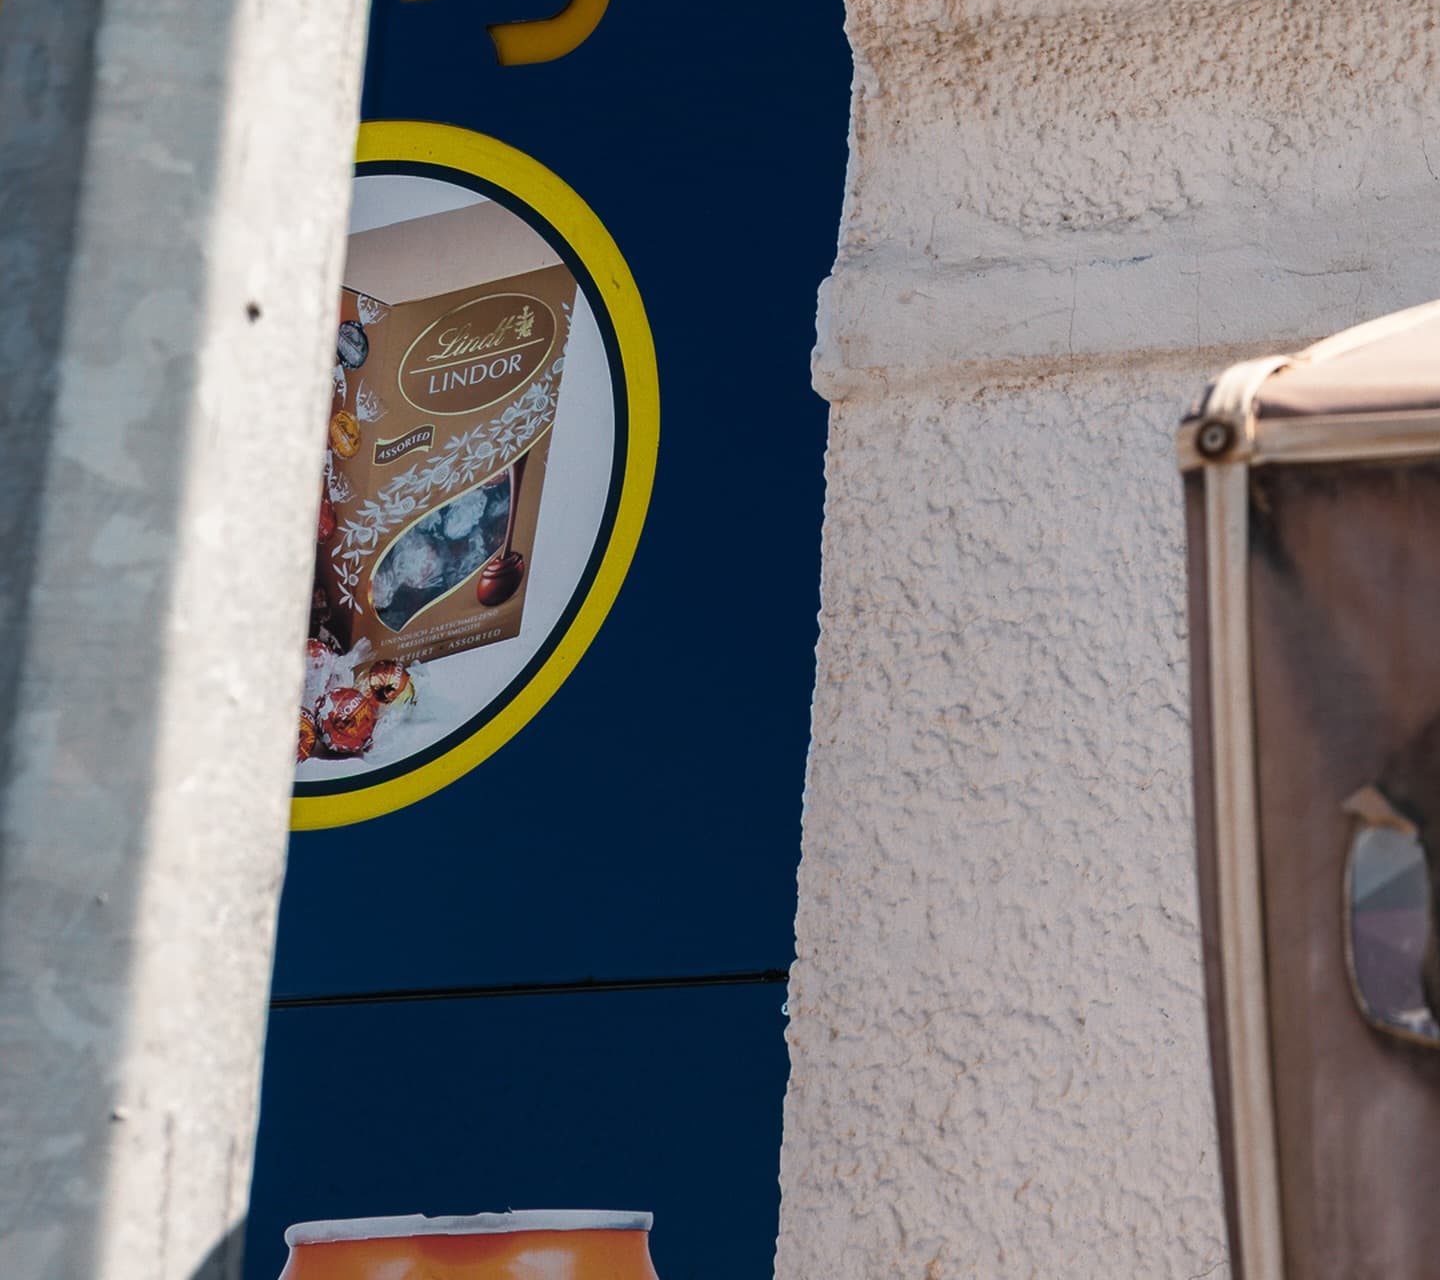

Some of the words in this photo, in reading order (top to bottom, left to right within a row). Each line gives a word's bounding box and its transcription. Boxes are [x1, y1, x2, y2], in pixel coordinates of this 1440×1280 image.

[426, 314, 516, 362] Lindt
[428, 353, 522, 395] LINDOR
[377, 431, 431, 460] ASSORTED
[448, 627, 502, 650] ASSORTED
